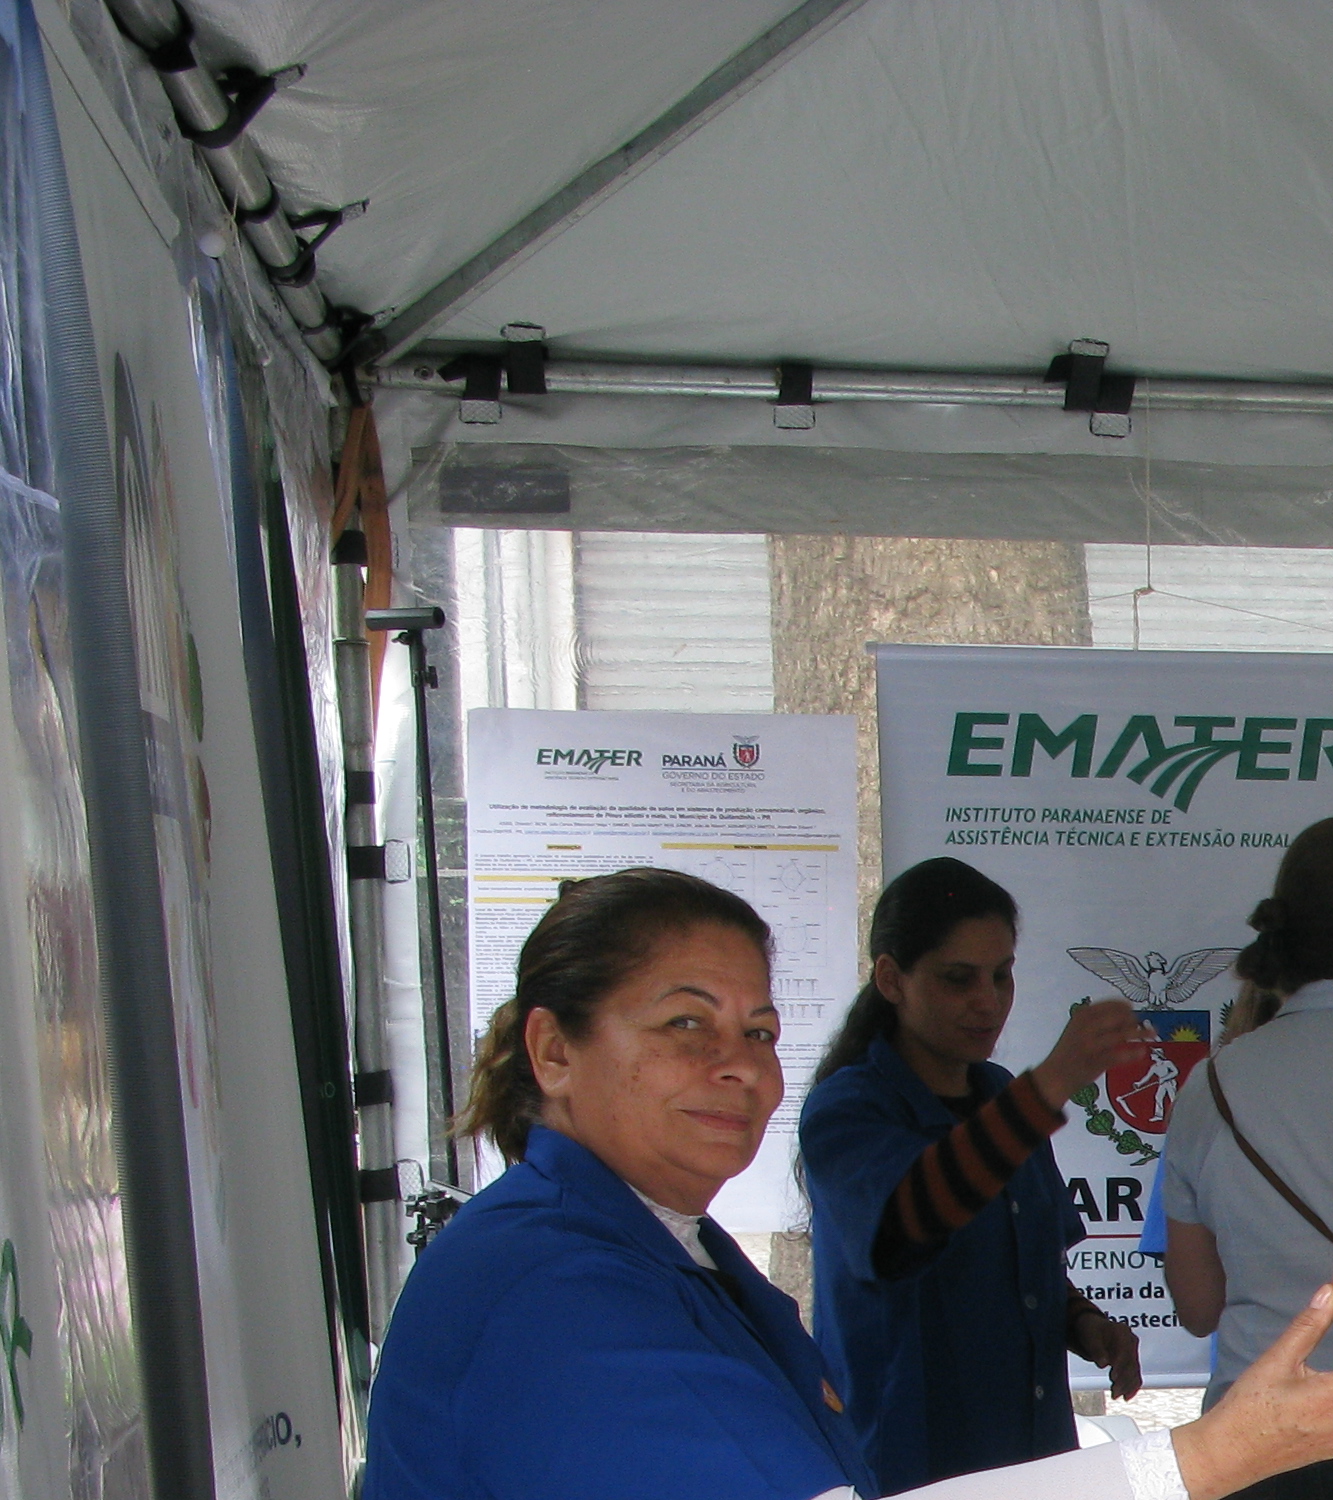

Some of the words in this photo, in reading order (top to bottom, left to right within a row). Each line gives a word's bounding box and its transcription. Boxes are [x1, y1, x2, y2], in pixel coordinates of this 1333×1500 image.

[537, 749, 643, 774] EMATER
[662, 752, 726, 767] PARANÁ
[662, 772, 709, 780] GOVERNO
[728, 772, 764, 780] ESTADO
[945, 807, 1038, 824] INSTITUTO
[1041, 807, 1146, 825] PARANAENSE
[1150, 809, 1172, 825] DE
[945, 827, 1050, 847] ASSISTÊNCIA
[1055, 827, 1127, 848] TÉCNICA
[1131, 830, 1141, 847] E
[1146, 827, 1236, 848] EXTENSÃO
[1240, 832, 1292, 849] RURAL
[1066, 1251, 1145, 1270] VERNO
[1139, 1281, 1164, 1299] da
